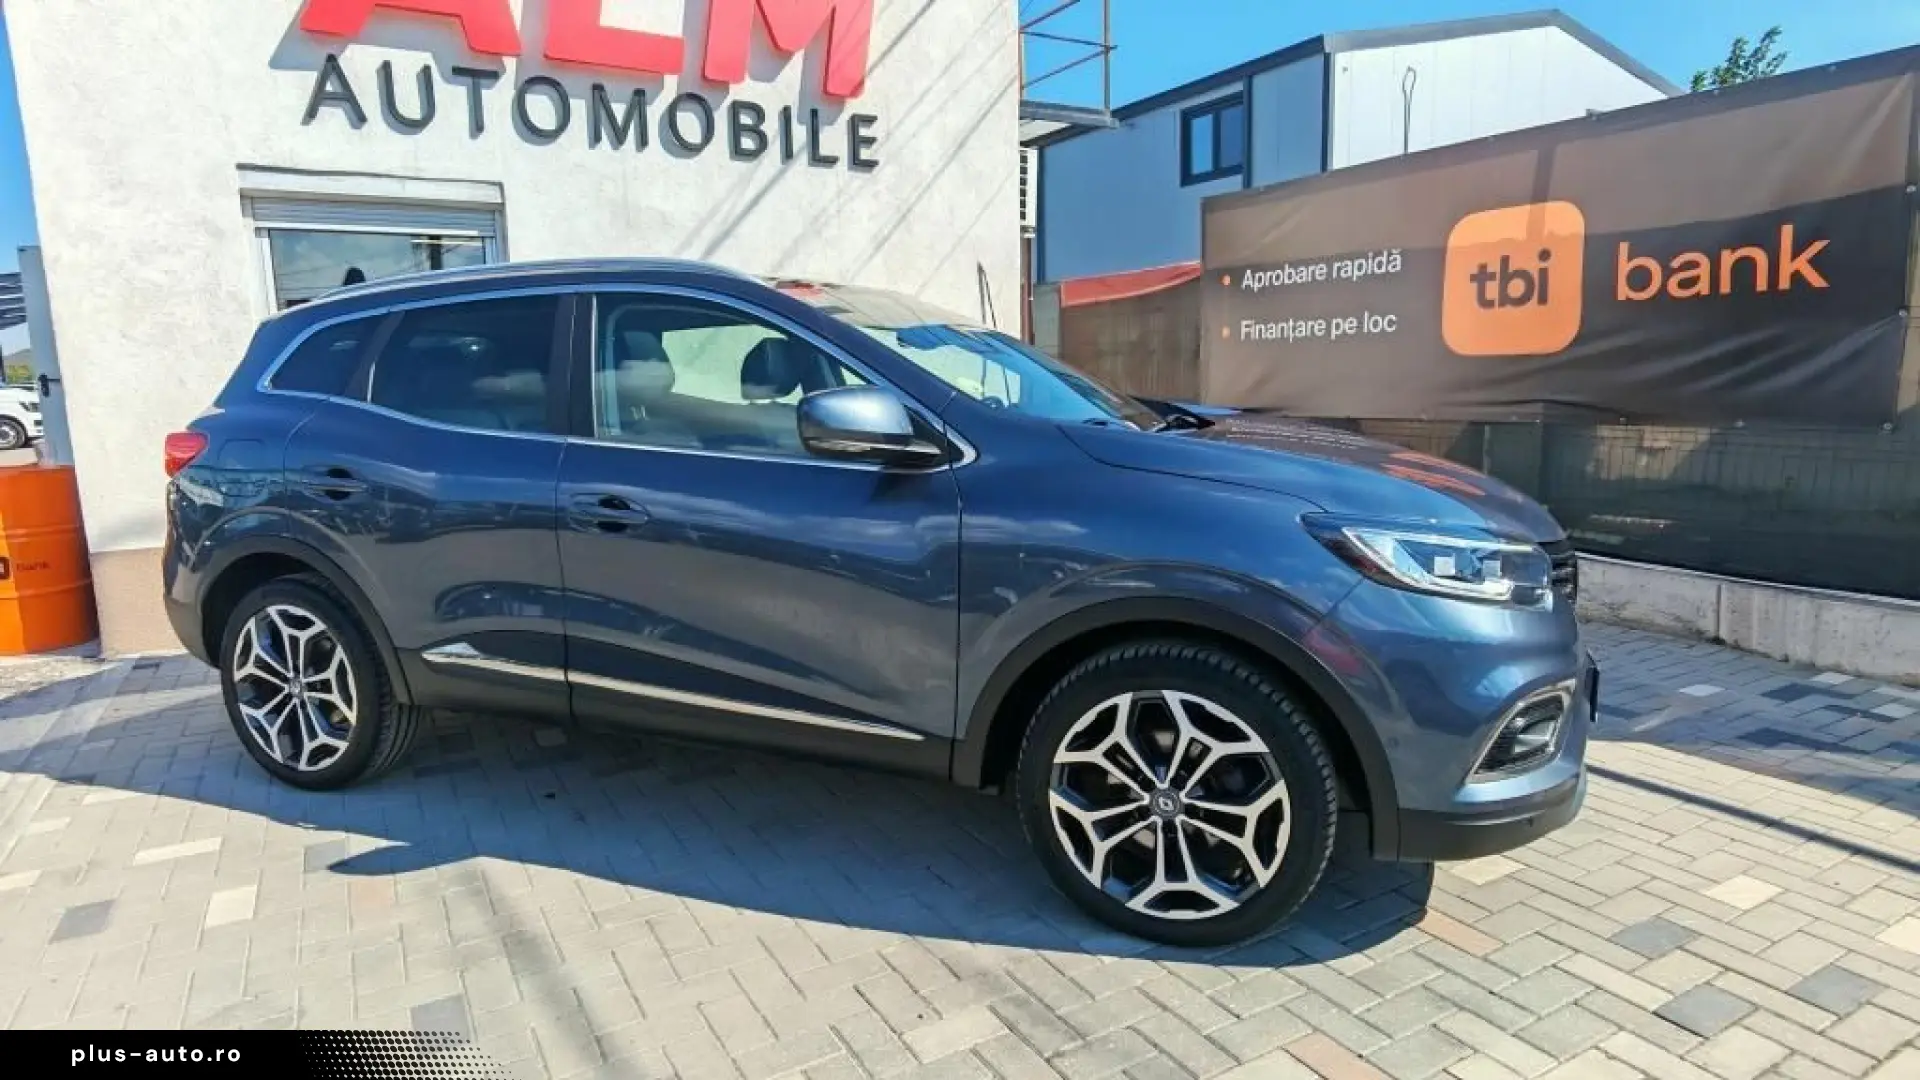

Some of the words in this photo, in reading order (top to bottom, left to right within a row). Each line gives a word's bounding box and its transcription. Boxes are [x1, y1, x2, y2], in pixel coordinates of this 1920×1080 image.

[302, 54, 879, 171] AUTOMOBILE
[1241, 262, 1328, 292] Aprobare
[1332, 248, 1402, 282] rapidă
[1469, 247, 1550, 310] tbi
[1616, 224, 1831, 302] bank
[1240, 318, 1327, 343] Finanțare
[1330, 315, 1358, 340] pe
[1363, 310, 1398, 334] loc
